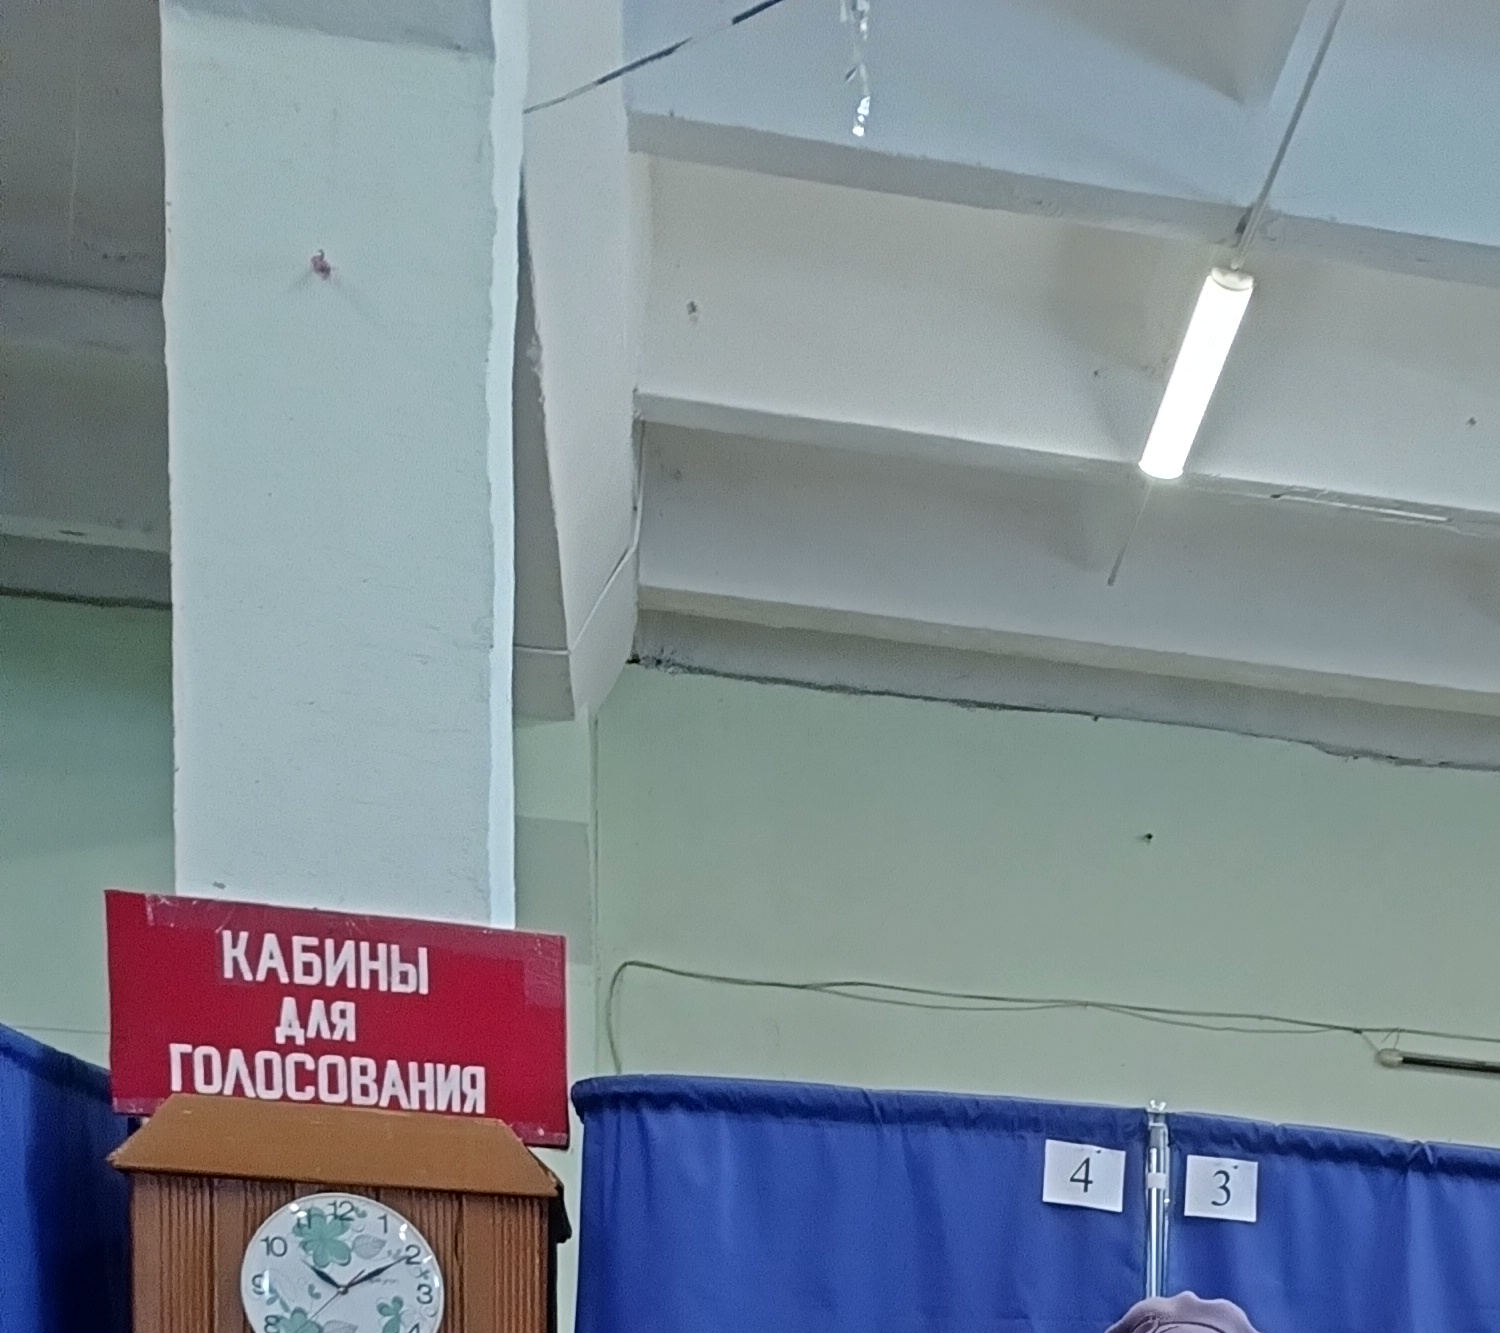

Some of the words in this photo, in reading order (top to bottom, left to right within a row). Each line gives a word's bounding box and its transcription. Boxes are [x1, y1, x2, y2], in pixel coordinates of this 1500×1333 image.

[222, 930, 429, 994] КАБИНЫ
[275, 997, 356, 1044] ДЛЯ
[169, 1043, 486, 1114] ГОЛОСОВАНИЯ
[1069, 1157, 1093, 1193] 4
[1211, 1170, 1231, 1206] 3
[328, 1200, 355, 1221] 12
[377, 1214, 388, 1234] 1
[261, 1236, 288, 1257] 10
[405, 1244, 421, 1265] 2
[416, 1284, 433, 1305] 3
